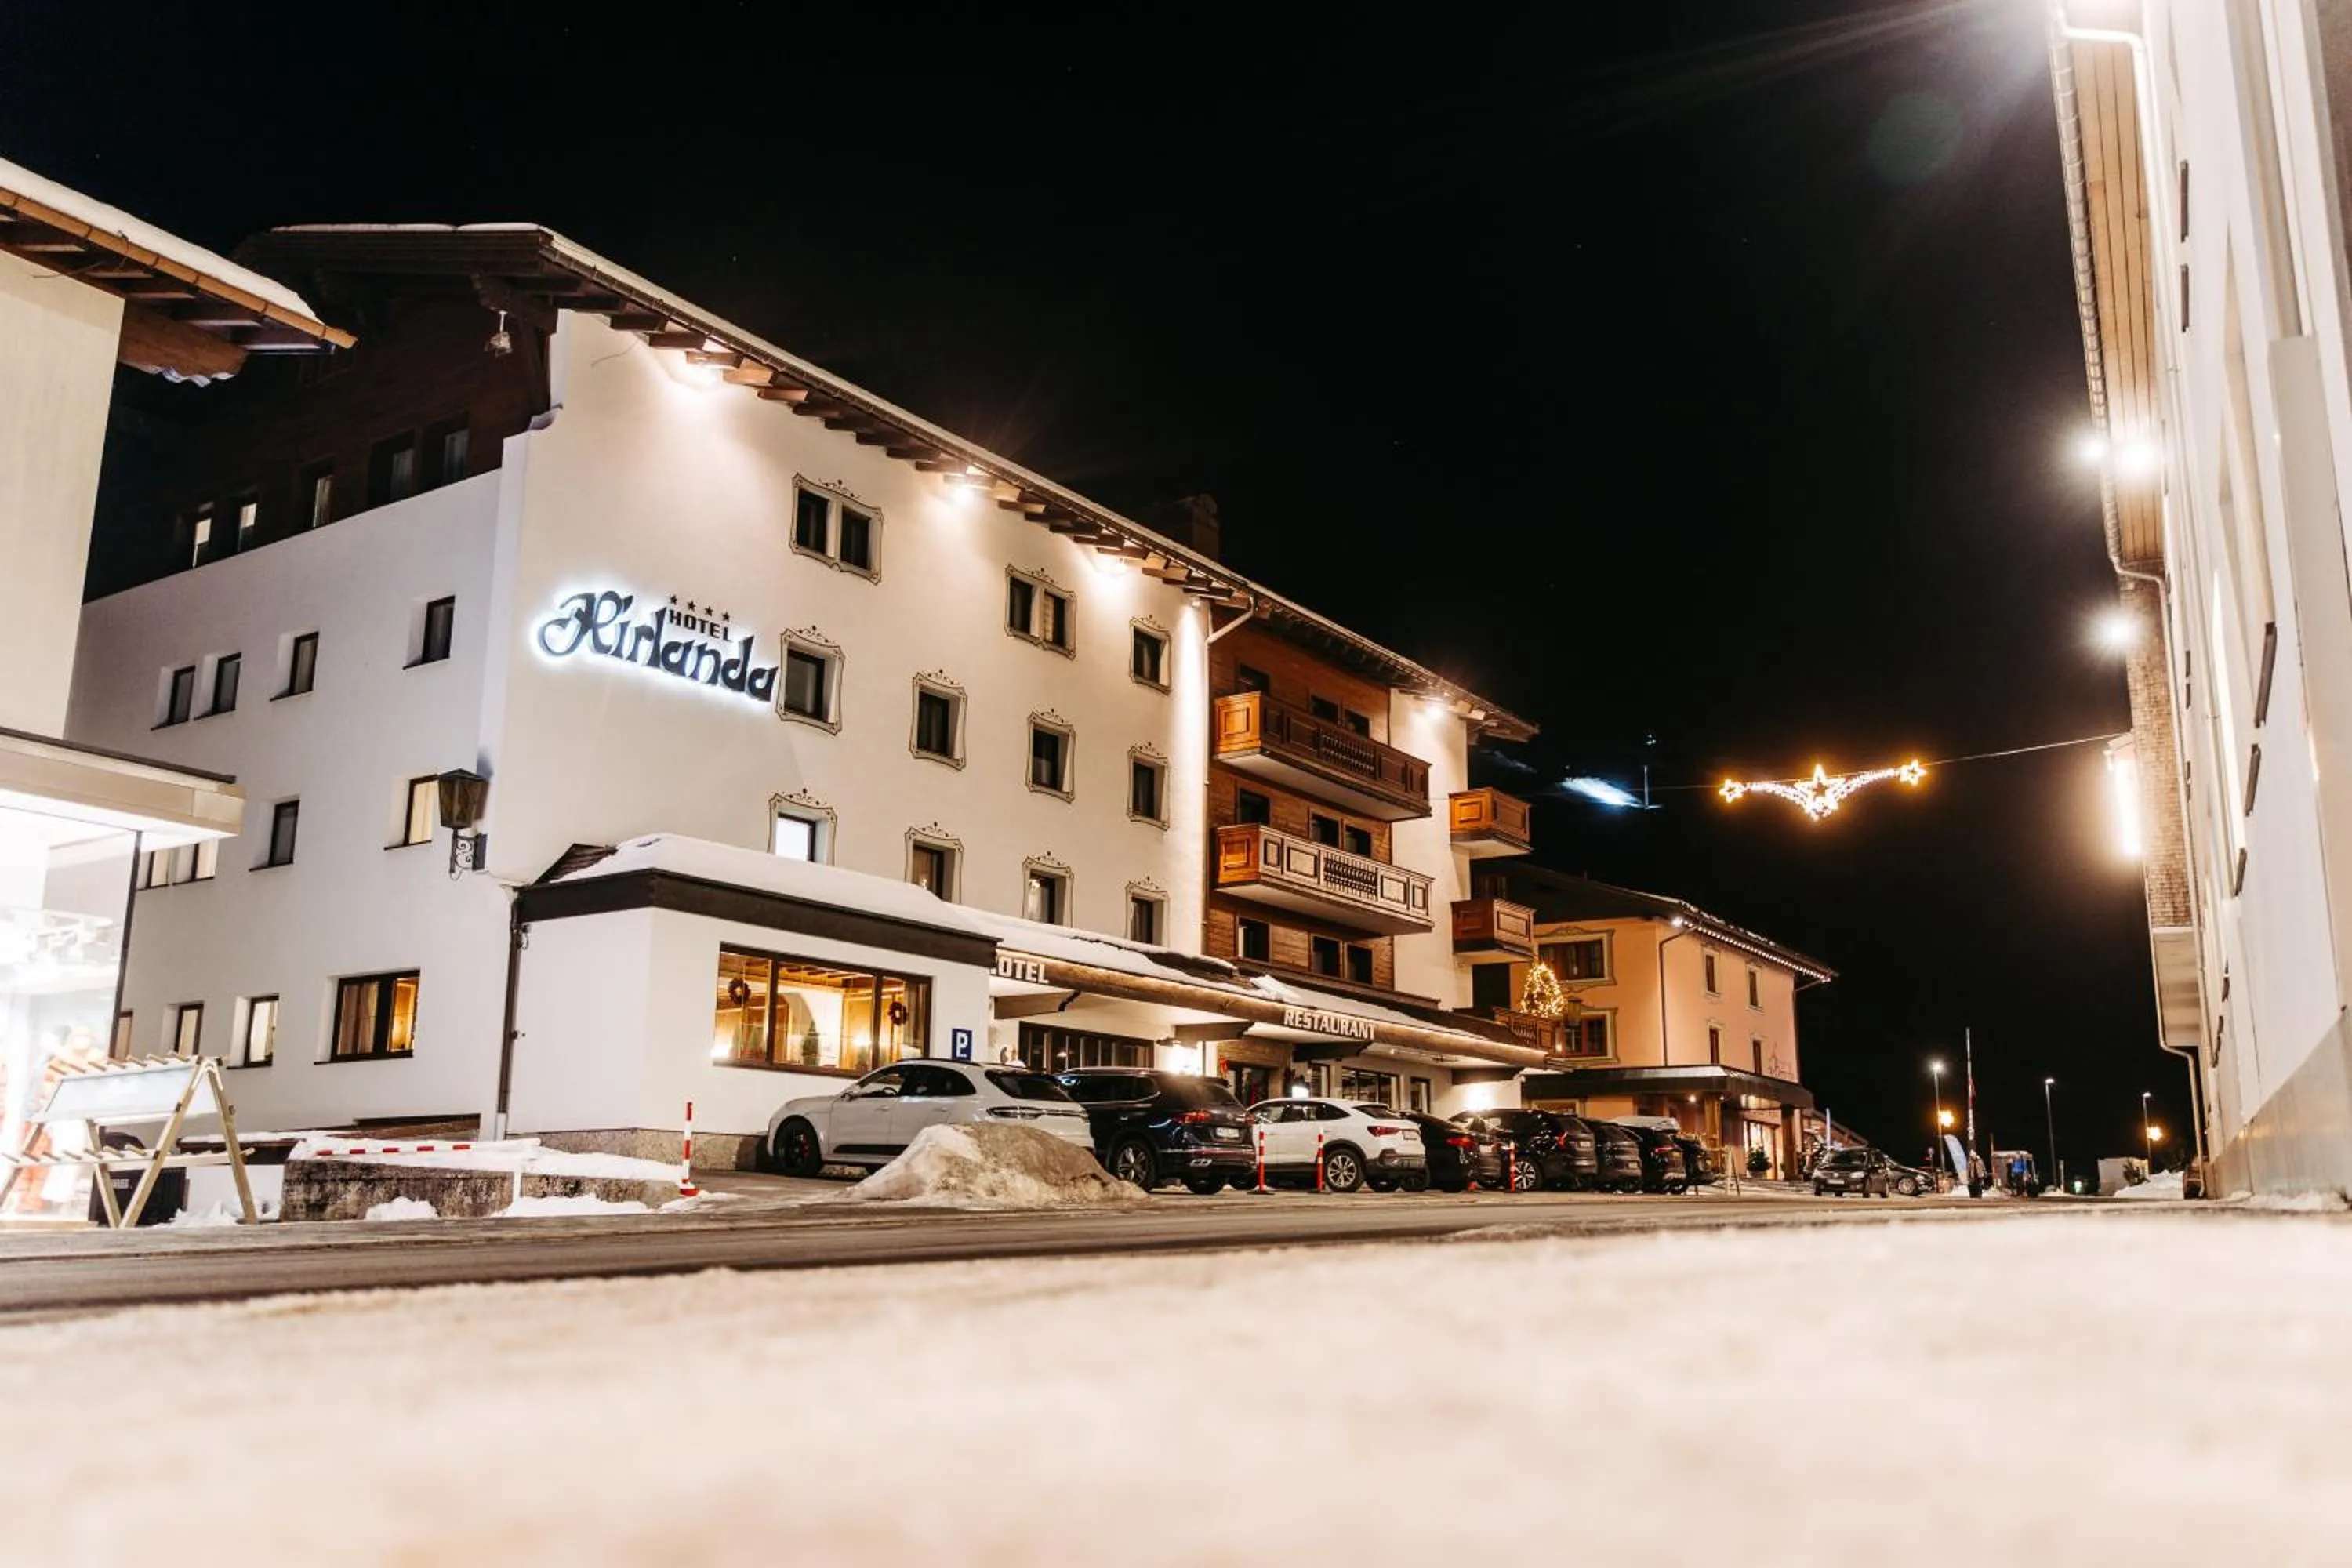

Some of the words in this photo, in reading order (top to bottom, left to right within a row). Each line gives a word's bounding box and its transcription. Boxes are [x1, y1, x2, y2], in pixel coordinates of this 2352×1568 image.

[669, 609, 731, 641] HOTEL
[538, 590, 779, 702] Hirlanda
[990, 956, 1050, 983] OTEL
[1283, 1009, 1376, 1040] RESTAURANT
[956, 1032, 968, 1058] P
